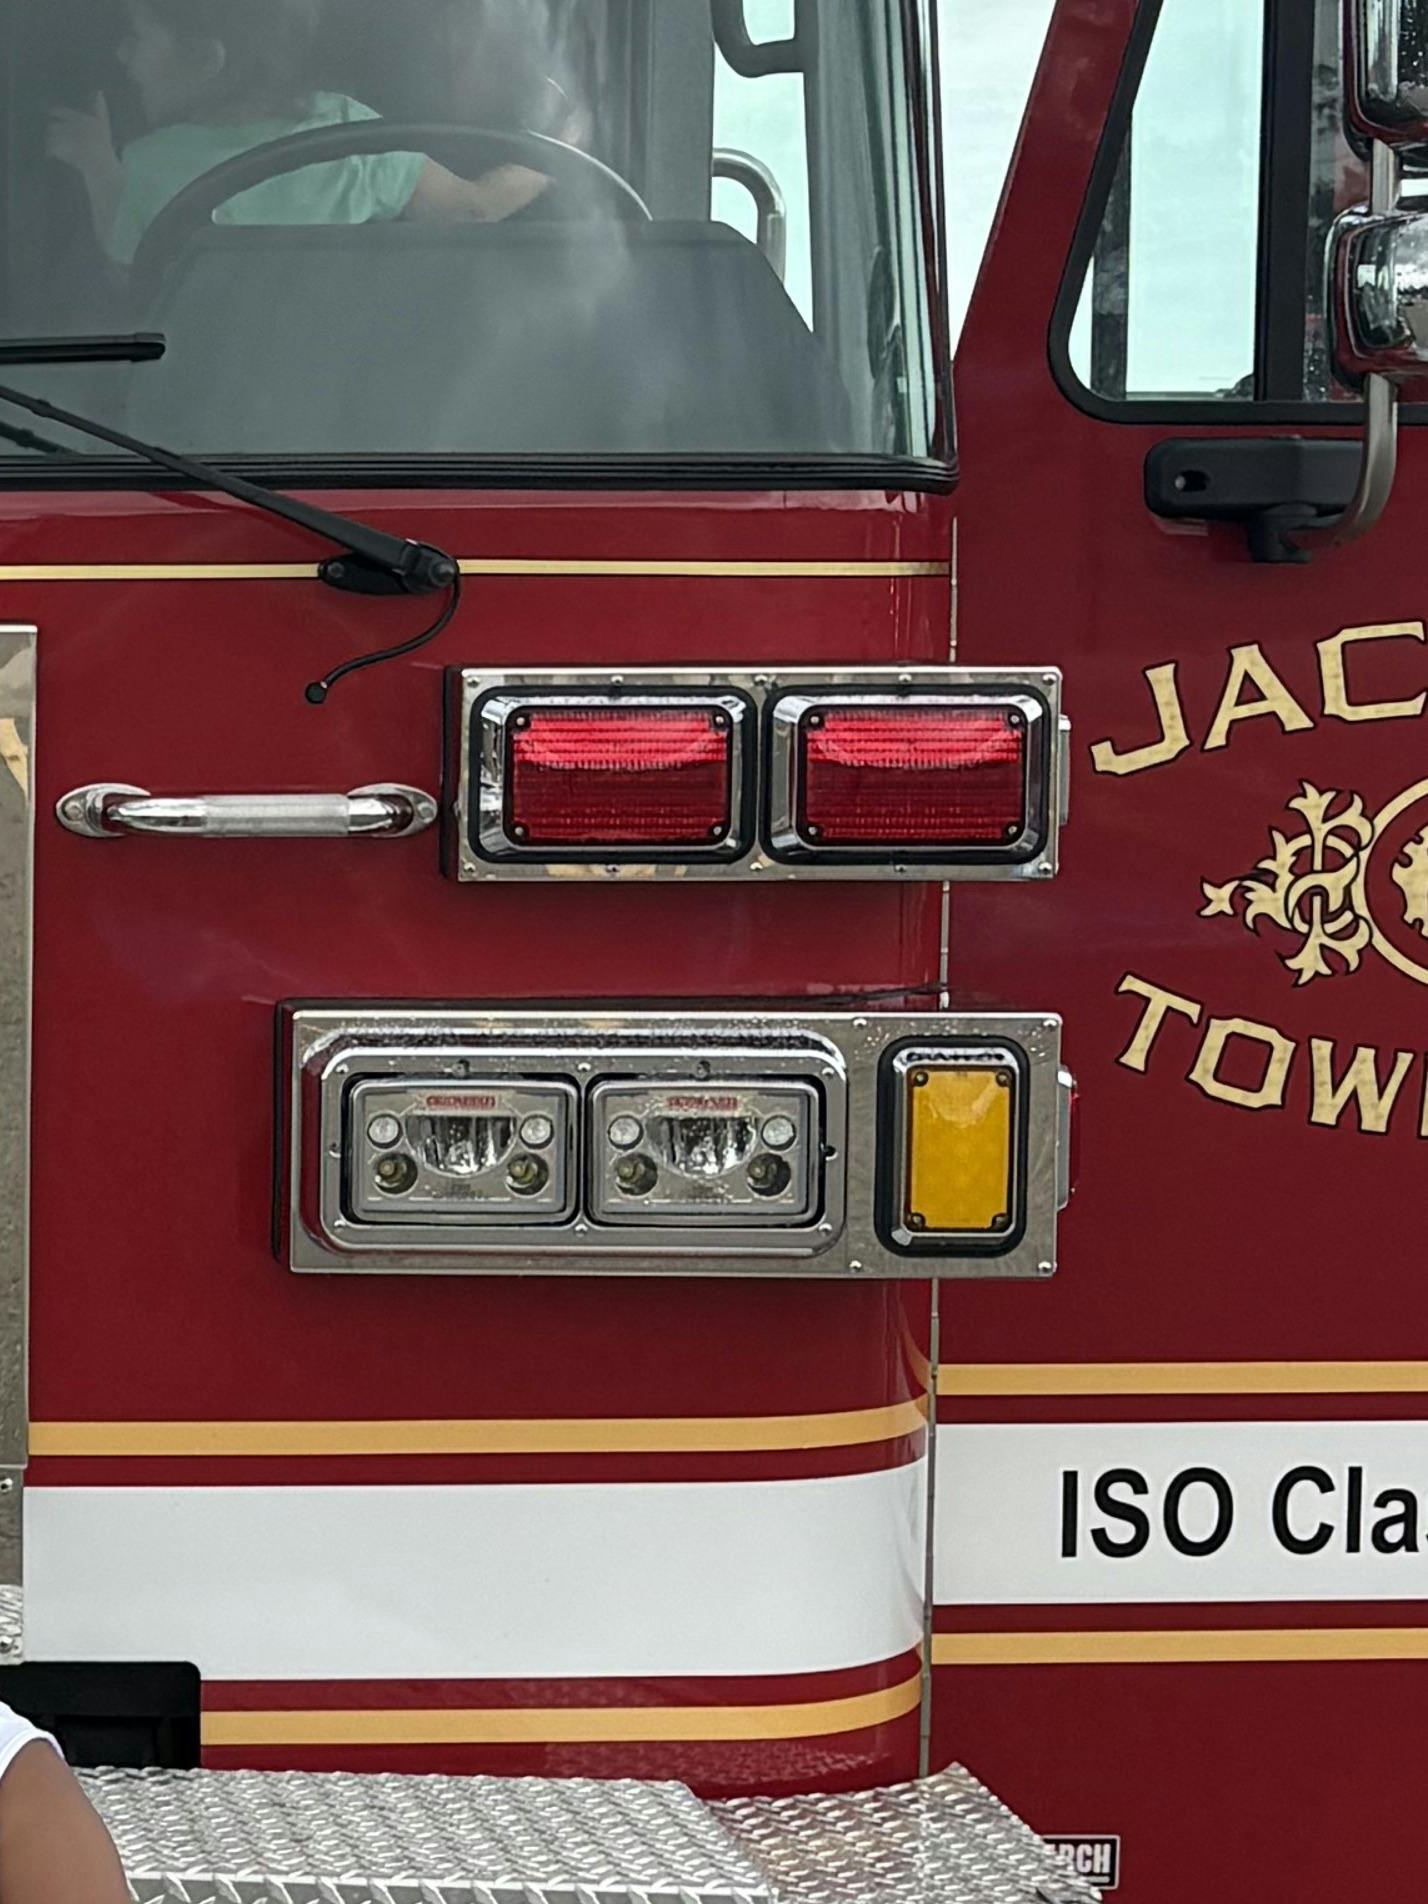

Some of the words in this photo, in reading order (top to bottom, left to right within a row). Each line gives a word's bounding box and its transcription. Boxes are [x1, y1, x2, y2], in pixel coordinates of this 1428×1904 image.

[1115, 971, 1428, 1138] TOW
[1061, 1466, 1234, 1558] ISO
[1271, 1464, 1428, 1556] Cla
